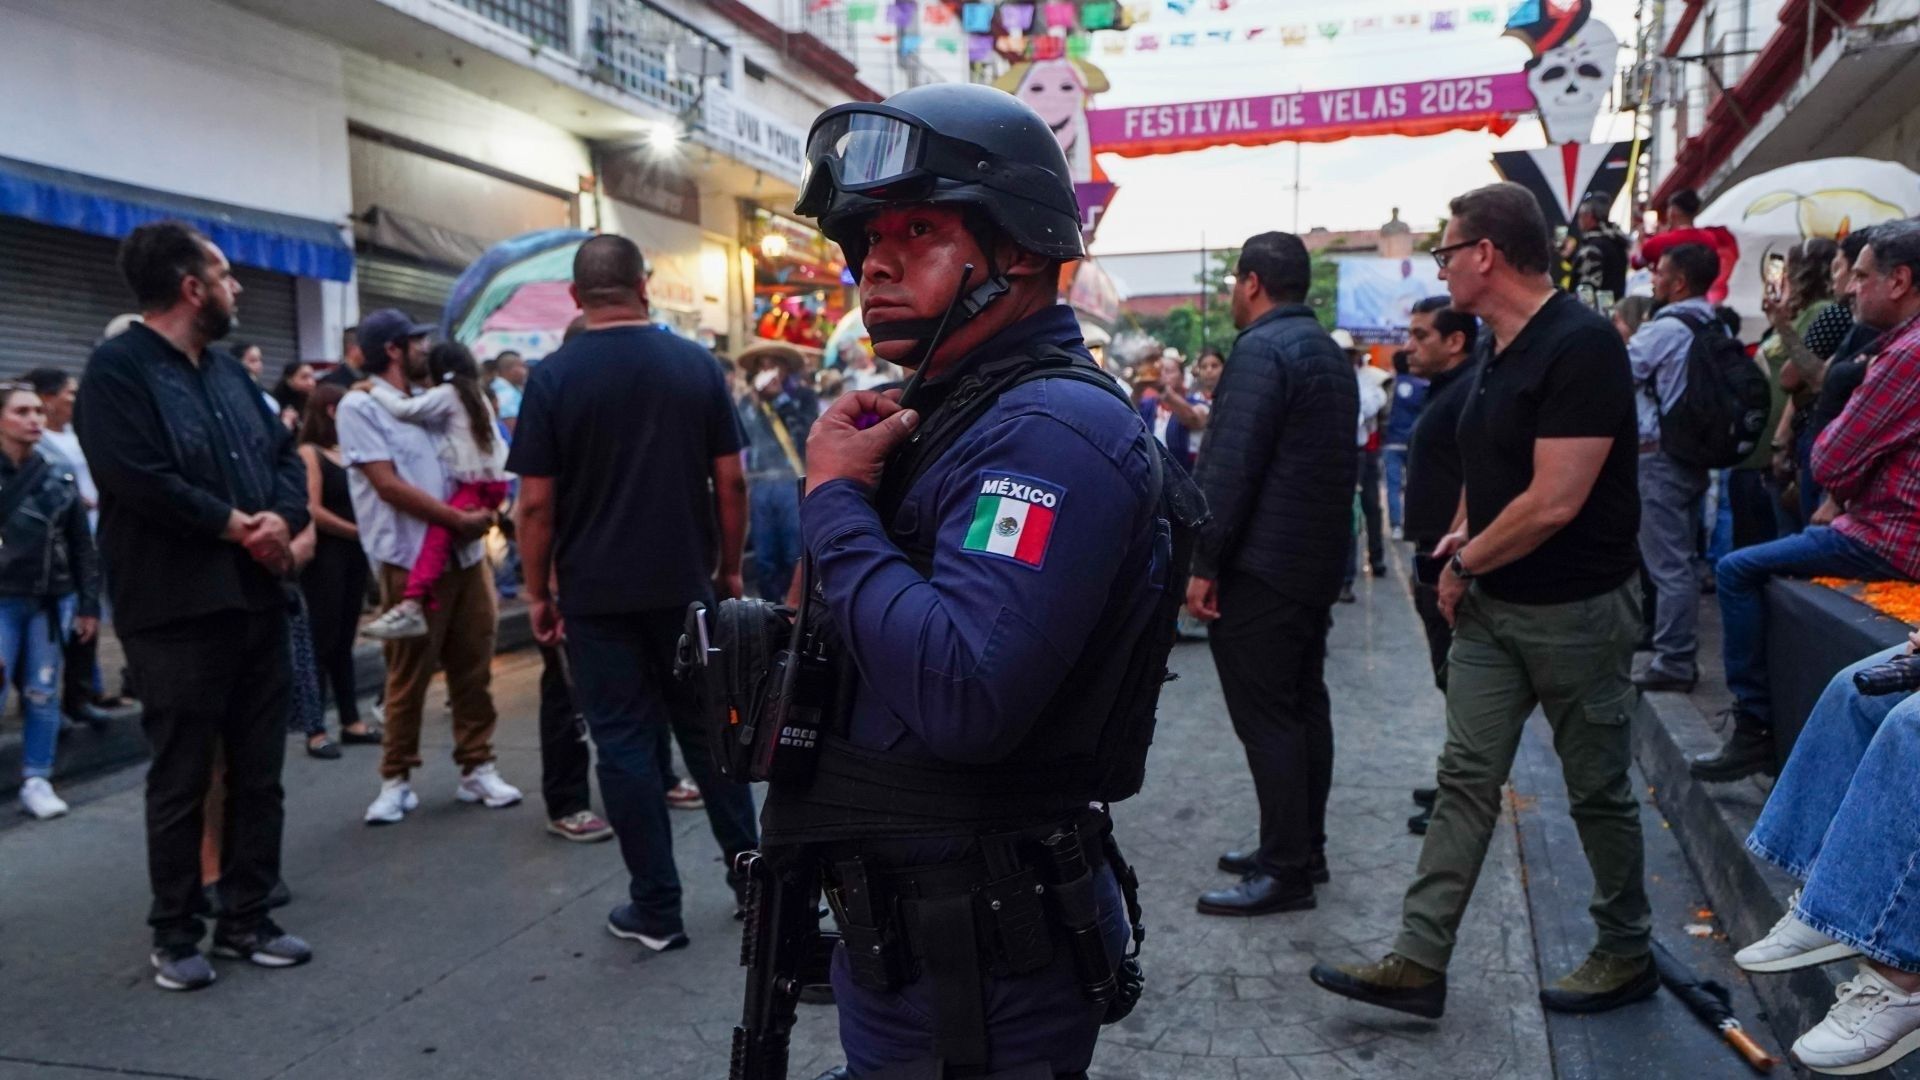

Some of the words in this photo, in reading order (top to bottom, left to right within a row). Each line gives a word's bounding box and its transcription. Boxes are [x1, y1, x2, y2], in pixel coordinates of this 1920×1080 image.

[1124, 103, 1258, 139] FESTIVAL
[1271, 93, 1305, 126] DE
[1319, 87, 1407, 123] VELAS
[1420, 78, 1494, 114] 2025
[980, 477, 1057, 508] MÉXICO
